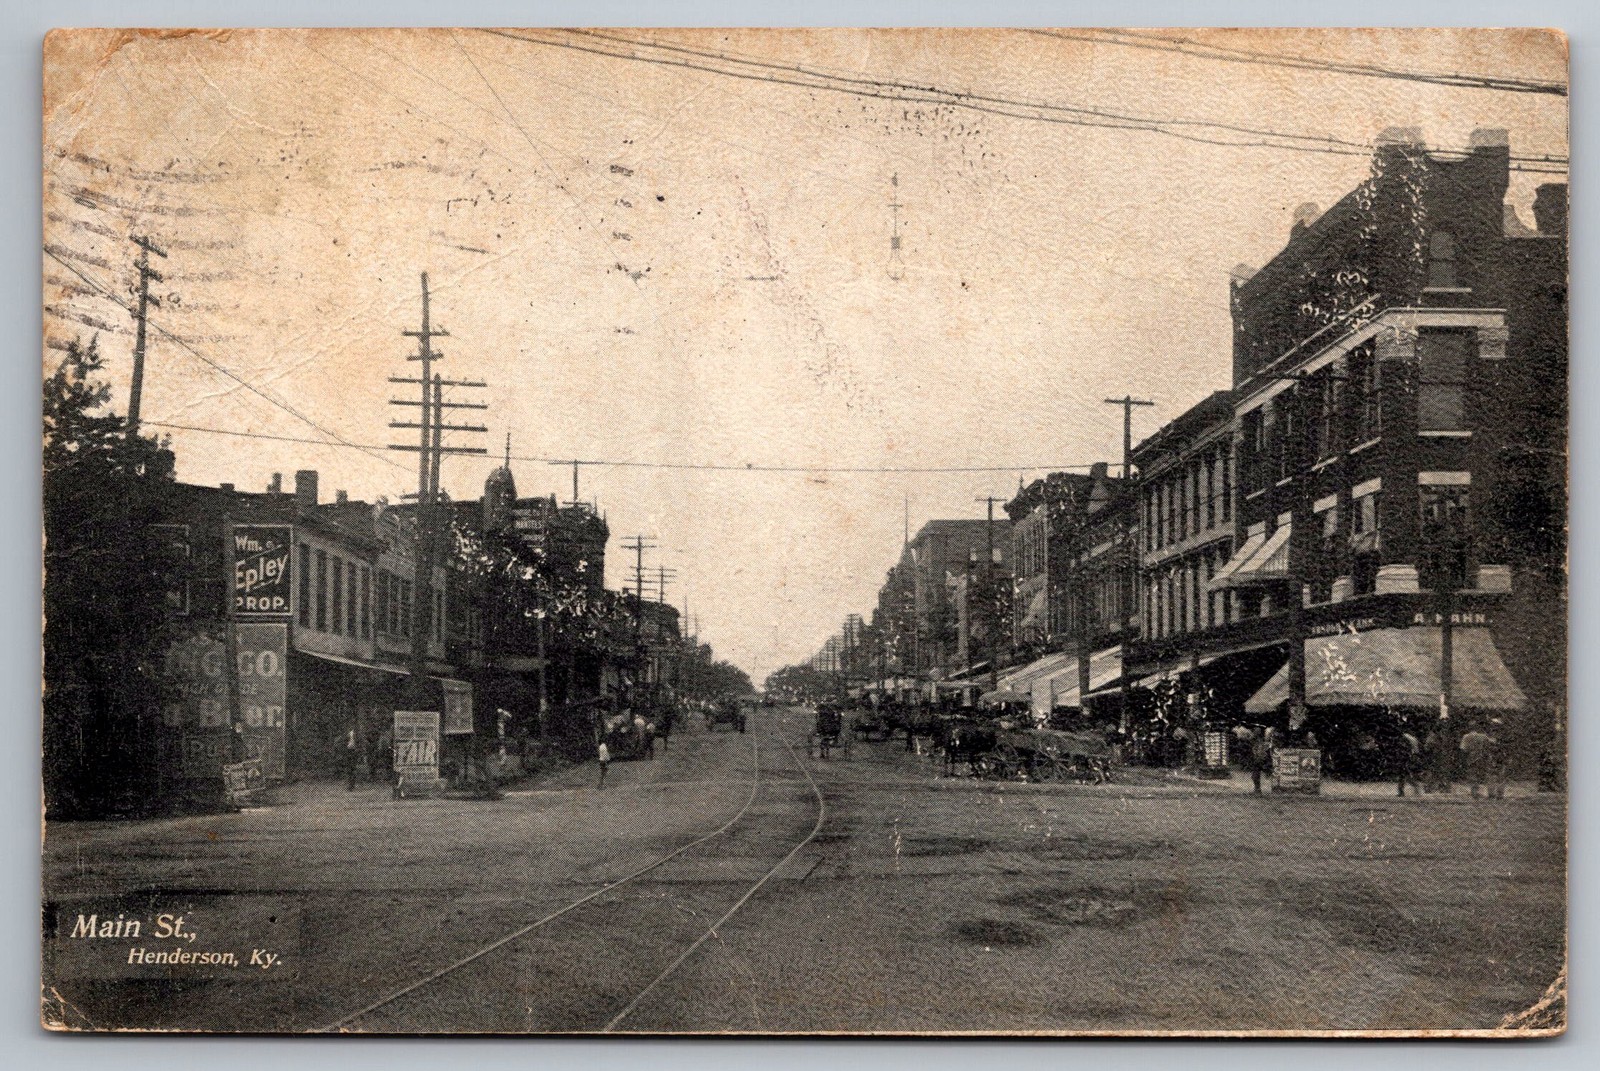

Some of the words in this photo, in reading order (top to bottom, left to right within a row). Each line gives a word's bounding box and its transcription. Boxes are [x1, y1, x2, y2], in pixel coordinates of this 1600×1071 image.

[234, 535, 263, 551] Wm.
[235, 554, 289, 593] Epley
[395, 741, 438, 765] FAIR
